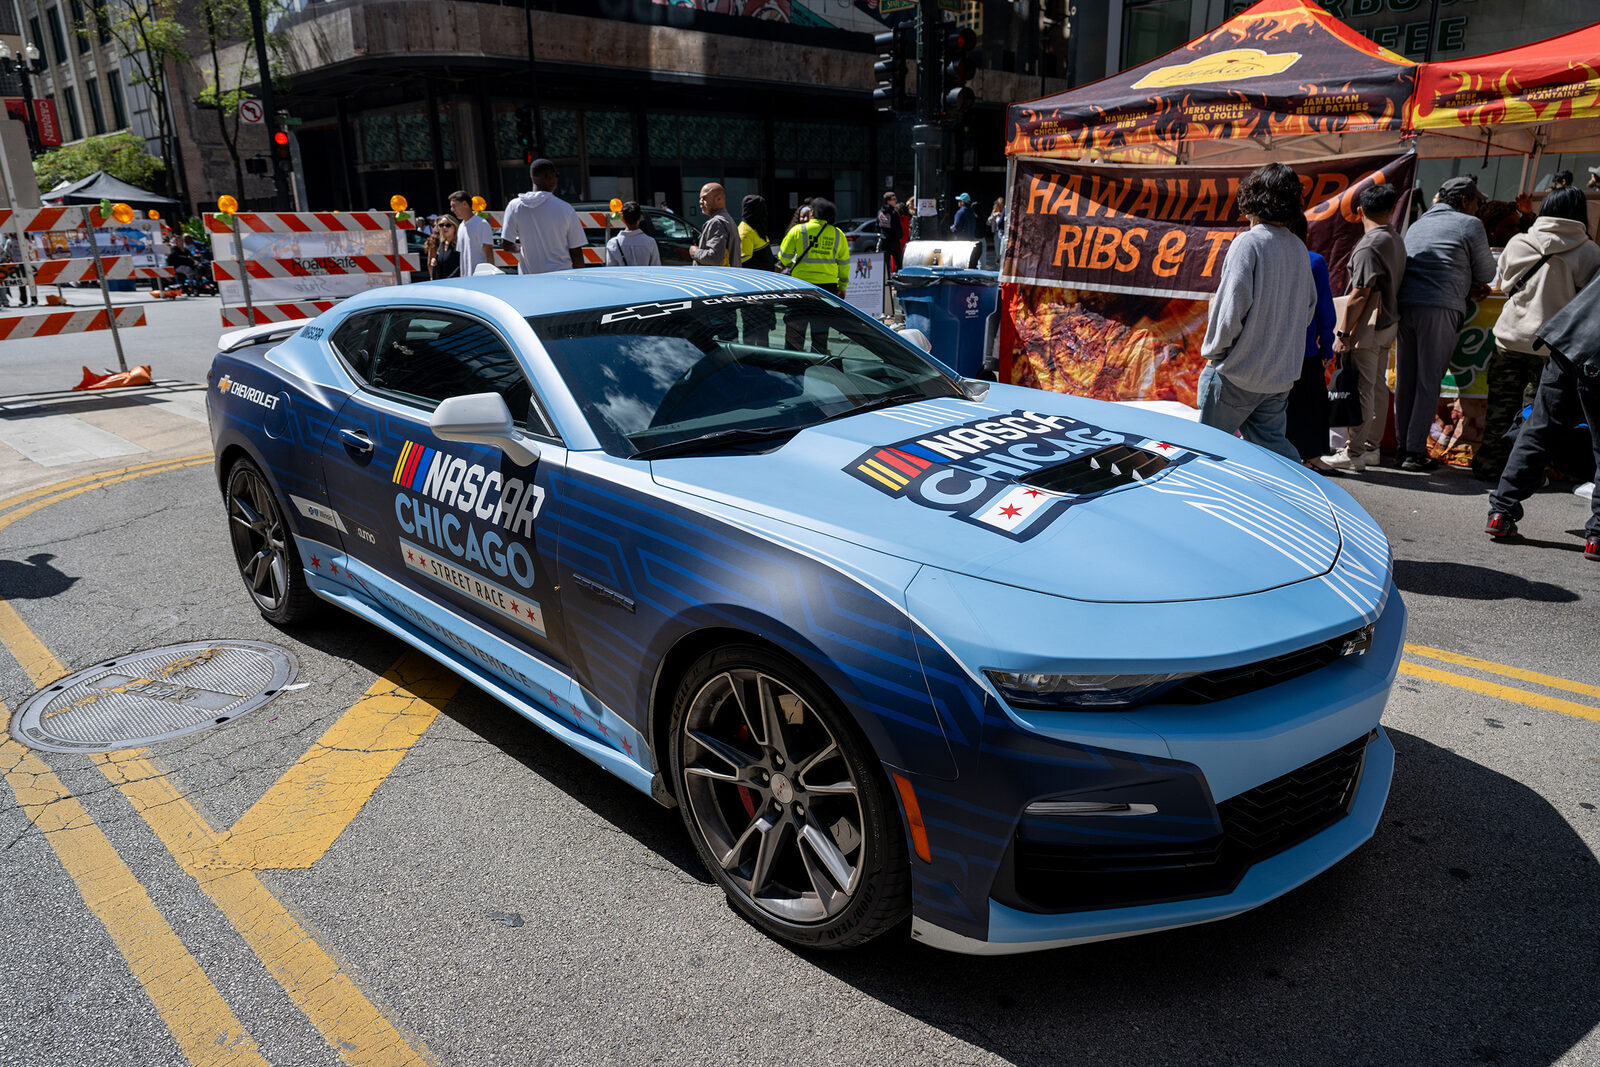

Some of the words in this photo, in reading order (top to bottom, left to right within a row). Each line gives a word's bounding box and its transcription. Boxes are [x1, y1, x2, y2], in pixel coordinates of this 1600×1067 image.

[1303, 95, 1359, 106] JAMAICAN
[1527, 90, 1580, 101] PLANTAINS
[1184, 105, 1207, 115] JERK
[1210, 102, 1252, 113] CHICKEN
[1296, 105, 1322, 114] BEEF
[1325, 102, 1369, 113] PATTIES
[1445, 99, 1487, 107] SAMOSAS
[1105, 112, 1148, 123] HAWAIIAN
[1192, 112, 1211, 121] EGG
[1213, 110, 1243, 120] ROLLS
[1117, 120, 1136, 129] RIBS
[1034, 127, 1068, 136] CHICKEN
[1052, 224, 1148, 273] RIBS
[1151, 230, 1187, 277] &
[291, 256, 357, 270] RoadSafe
[702, 293, 803, 306] CHEVROLET
[230, 382, 280, 411] CHEVROLET
[422, 451, 546, 539] NASCAR
[394, 492, 535, 589] CHICAGO
[431, 560, 471, 594] STREET
[477, 580, 506, 610] RACE
[378, 588, 431, 627] OFFICIAL
[435, 621, 468, 648] PACE
[468, 642, 532, 688] VEHICLE
[828, 883, 876, 940] GOODYEAR
